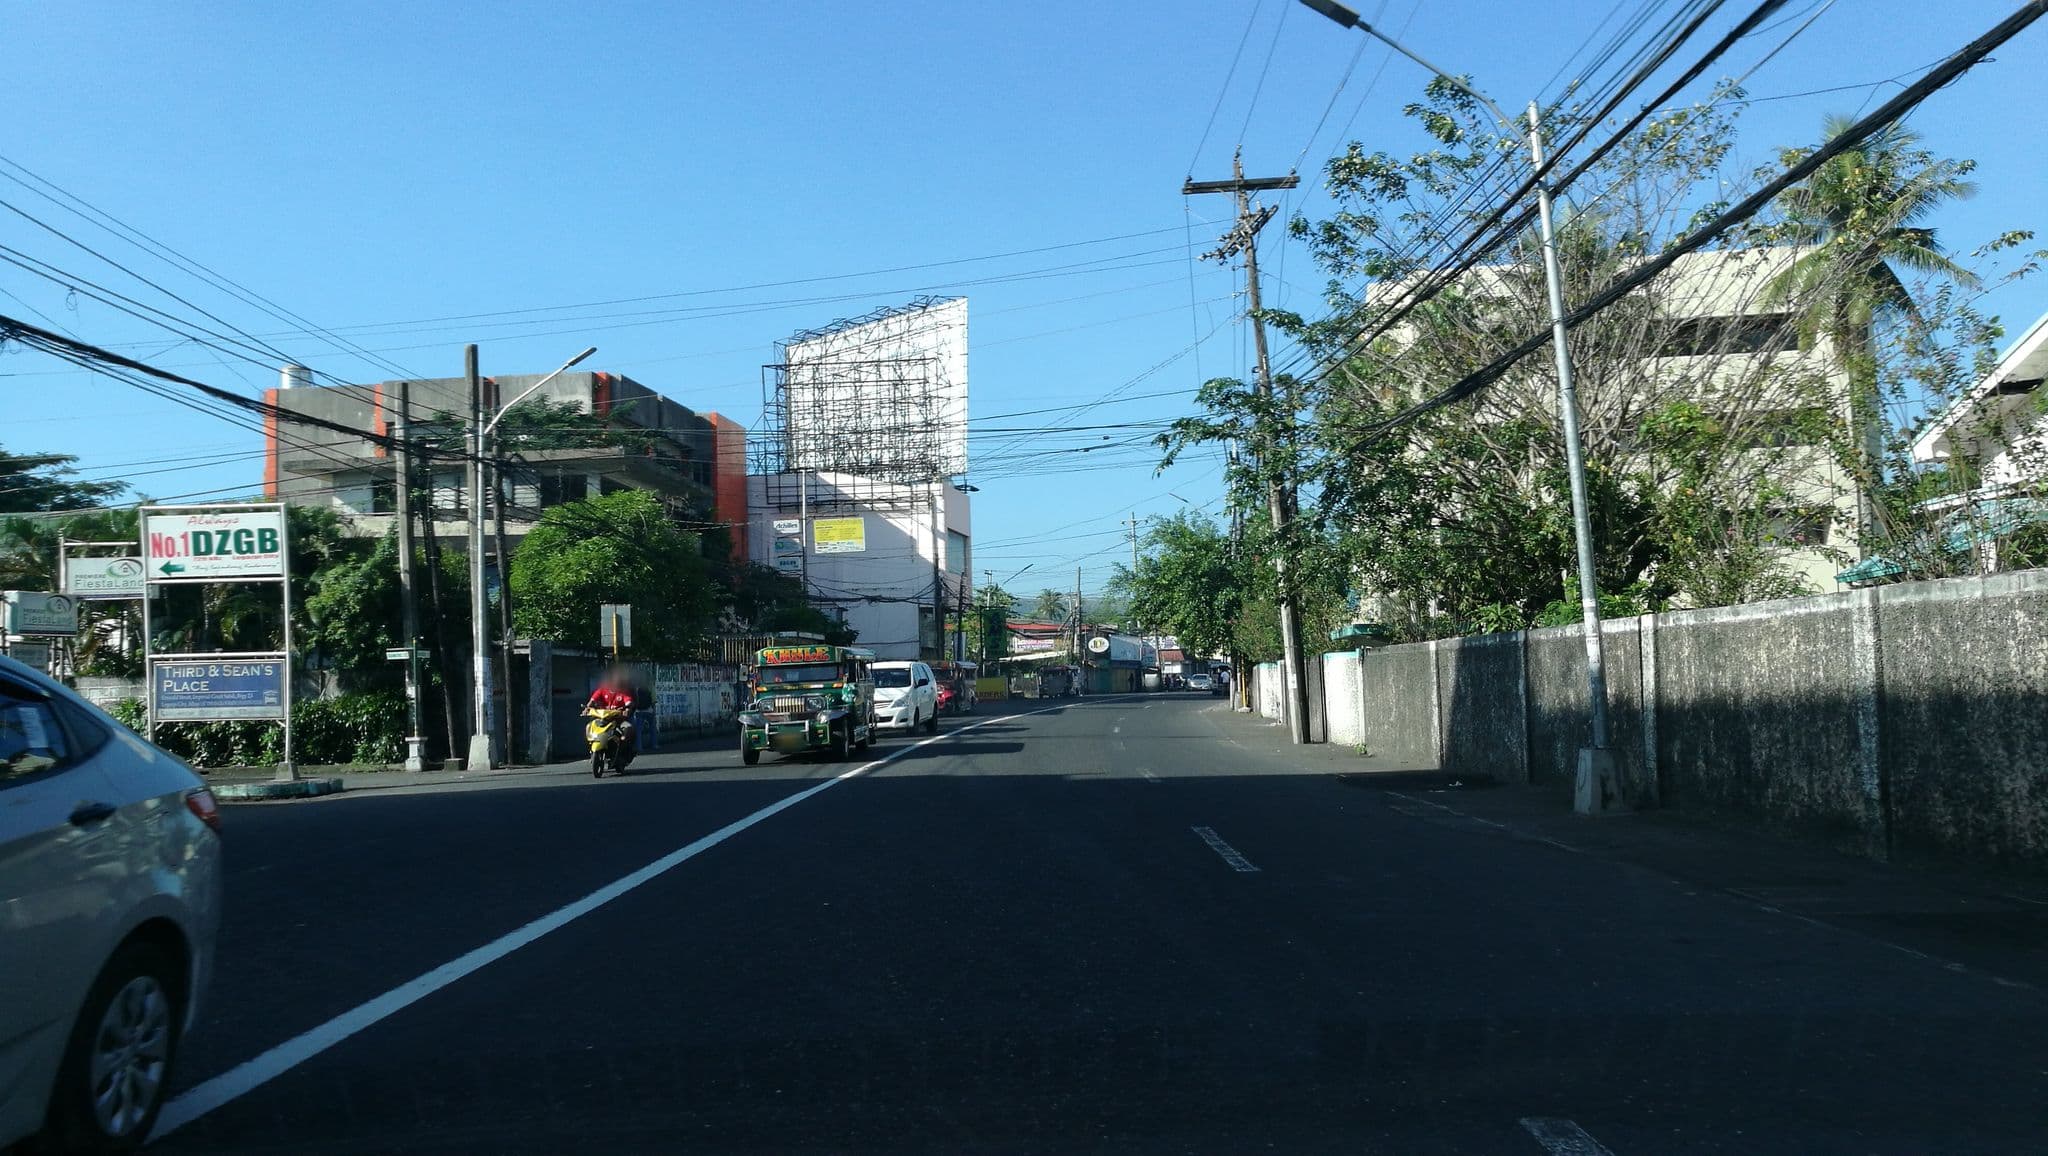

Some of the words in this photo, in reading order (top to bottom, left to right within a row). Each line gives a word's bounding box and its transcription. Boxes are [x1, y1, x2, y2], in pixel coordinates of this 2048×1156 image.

[188, 516, 240, 529] Always
[151, 531, 190, 559] No.1
[191, 528, 280, 557] DZGB
[162, 666, 205, 678] THIRD
[208, 665, 219, 677] &
[222, 664, 273, 677] SEAN'S
[163, 680, 209, 692] PLACE
